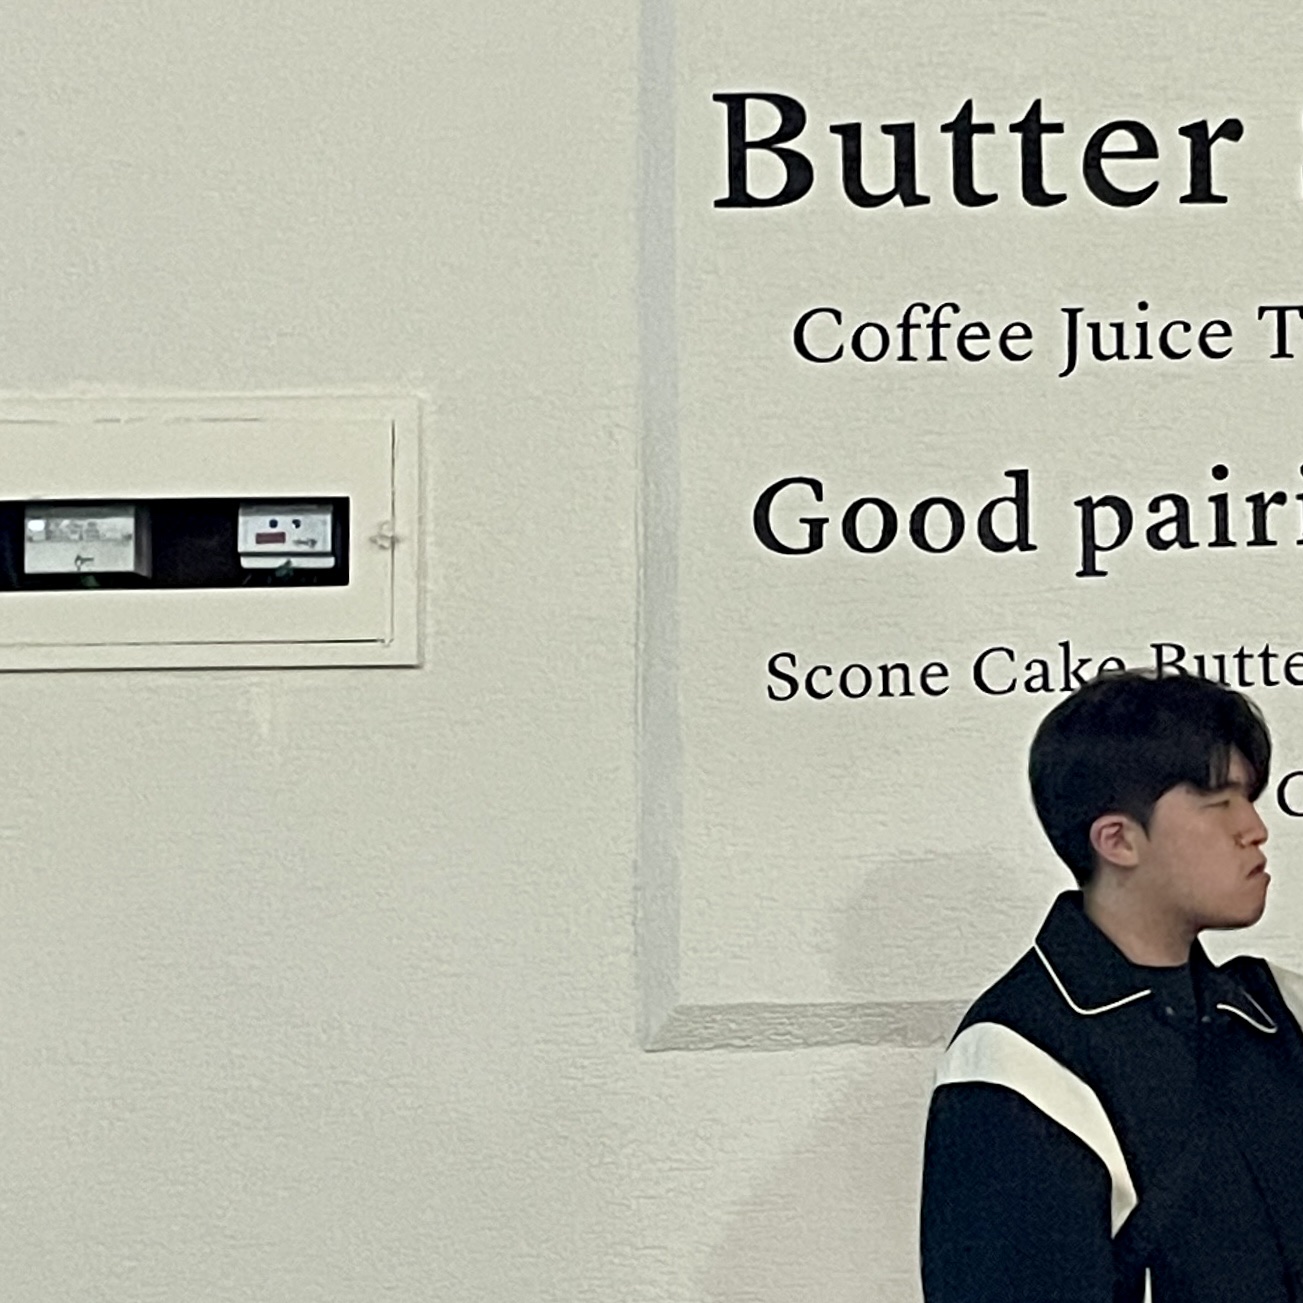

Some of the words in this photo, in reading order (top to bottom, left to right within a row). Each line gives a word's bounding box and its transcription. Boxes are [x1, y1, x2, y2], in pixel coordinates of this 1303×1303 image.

[713, 93, 1243, 208] Butter
[794, 303, 1032, 363] Coffee
[1059, 301, 1232, 377] Juice
[754, 469, 1037, 554] Good
[768, 653, 948, 701] Scone
